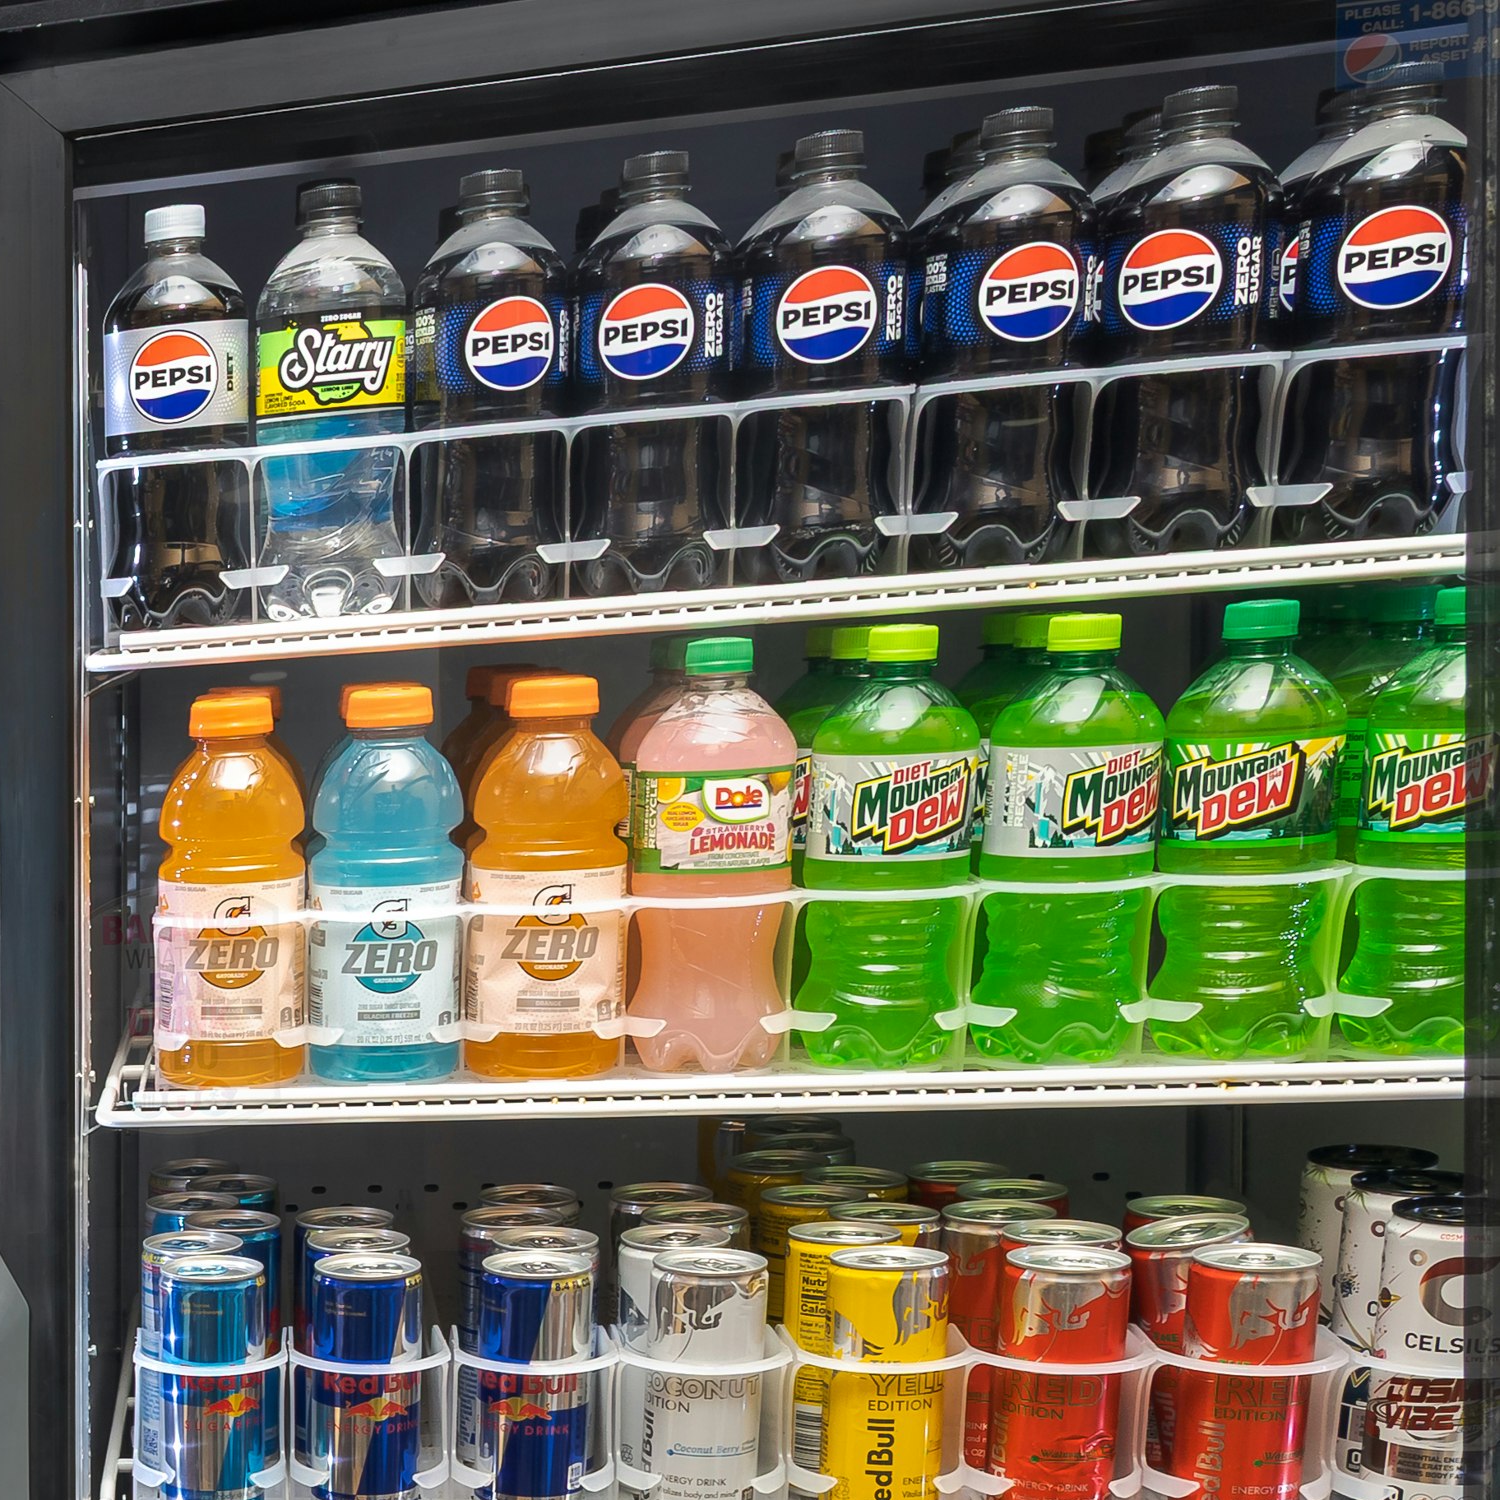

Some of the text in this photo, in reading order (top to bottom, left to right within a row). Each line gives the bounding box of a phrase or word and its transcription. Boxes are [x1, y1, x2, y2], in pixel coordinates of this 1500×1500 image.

[1233, 236, 1250, 305] ZERO
[1249, 235, 1262, 304] SUGAR
[1344, 242, 1447, 273] PEPSI
[604, 318, 689, 347] PEPSI
[226, 352, 235, 392] DIET
[281, 327, 393, 391] Starry
[135, 364, 213, 389] PEPSI
[892, 761, 932, 784] DIET
[715, 785, 763, 808] Dole
[689, 831, 776, 856] LEMONADE
[341, 938, 438, 975] ZERO
[868, 1397, 934, 1411] EDITION
